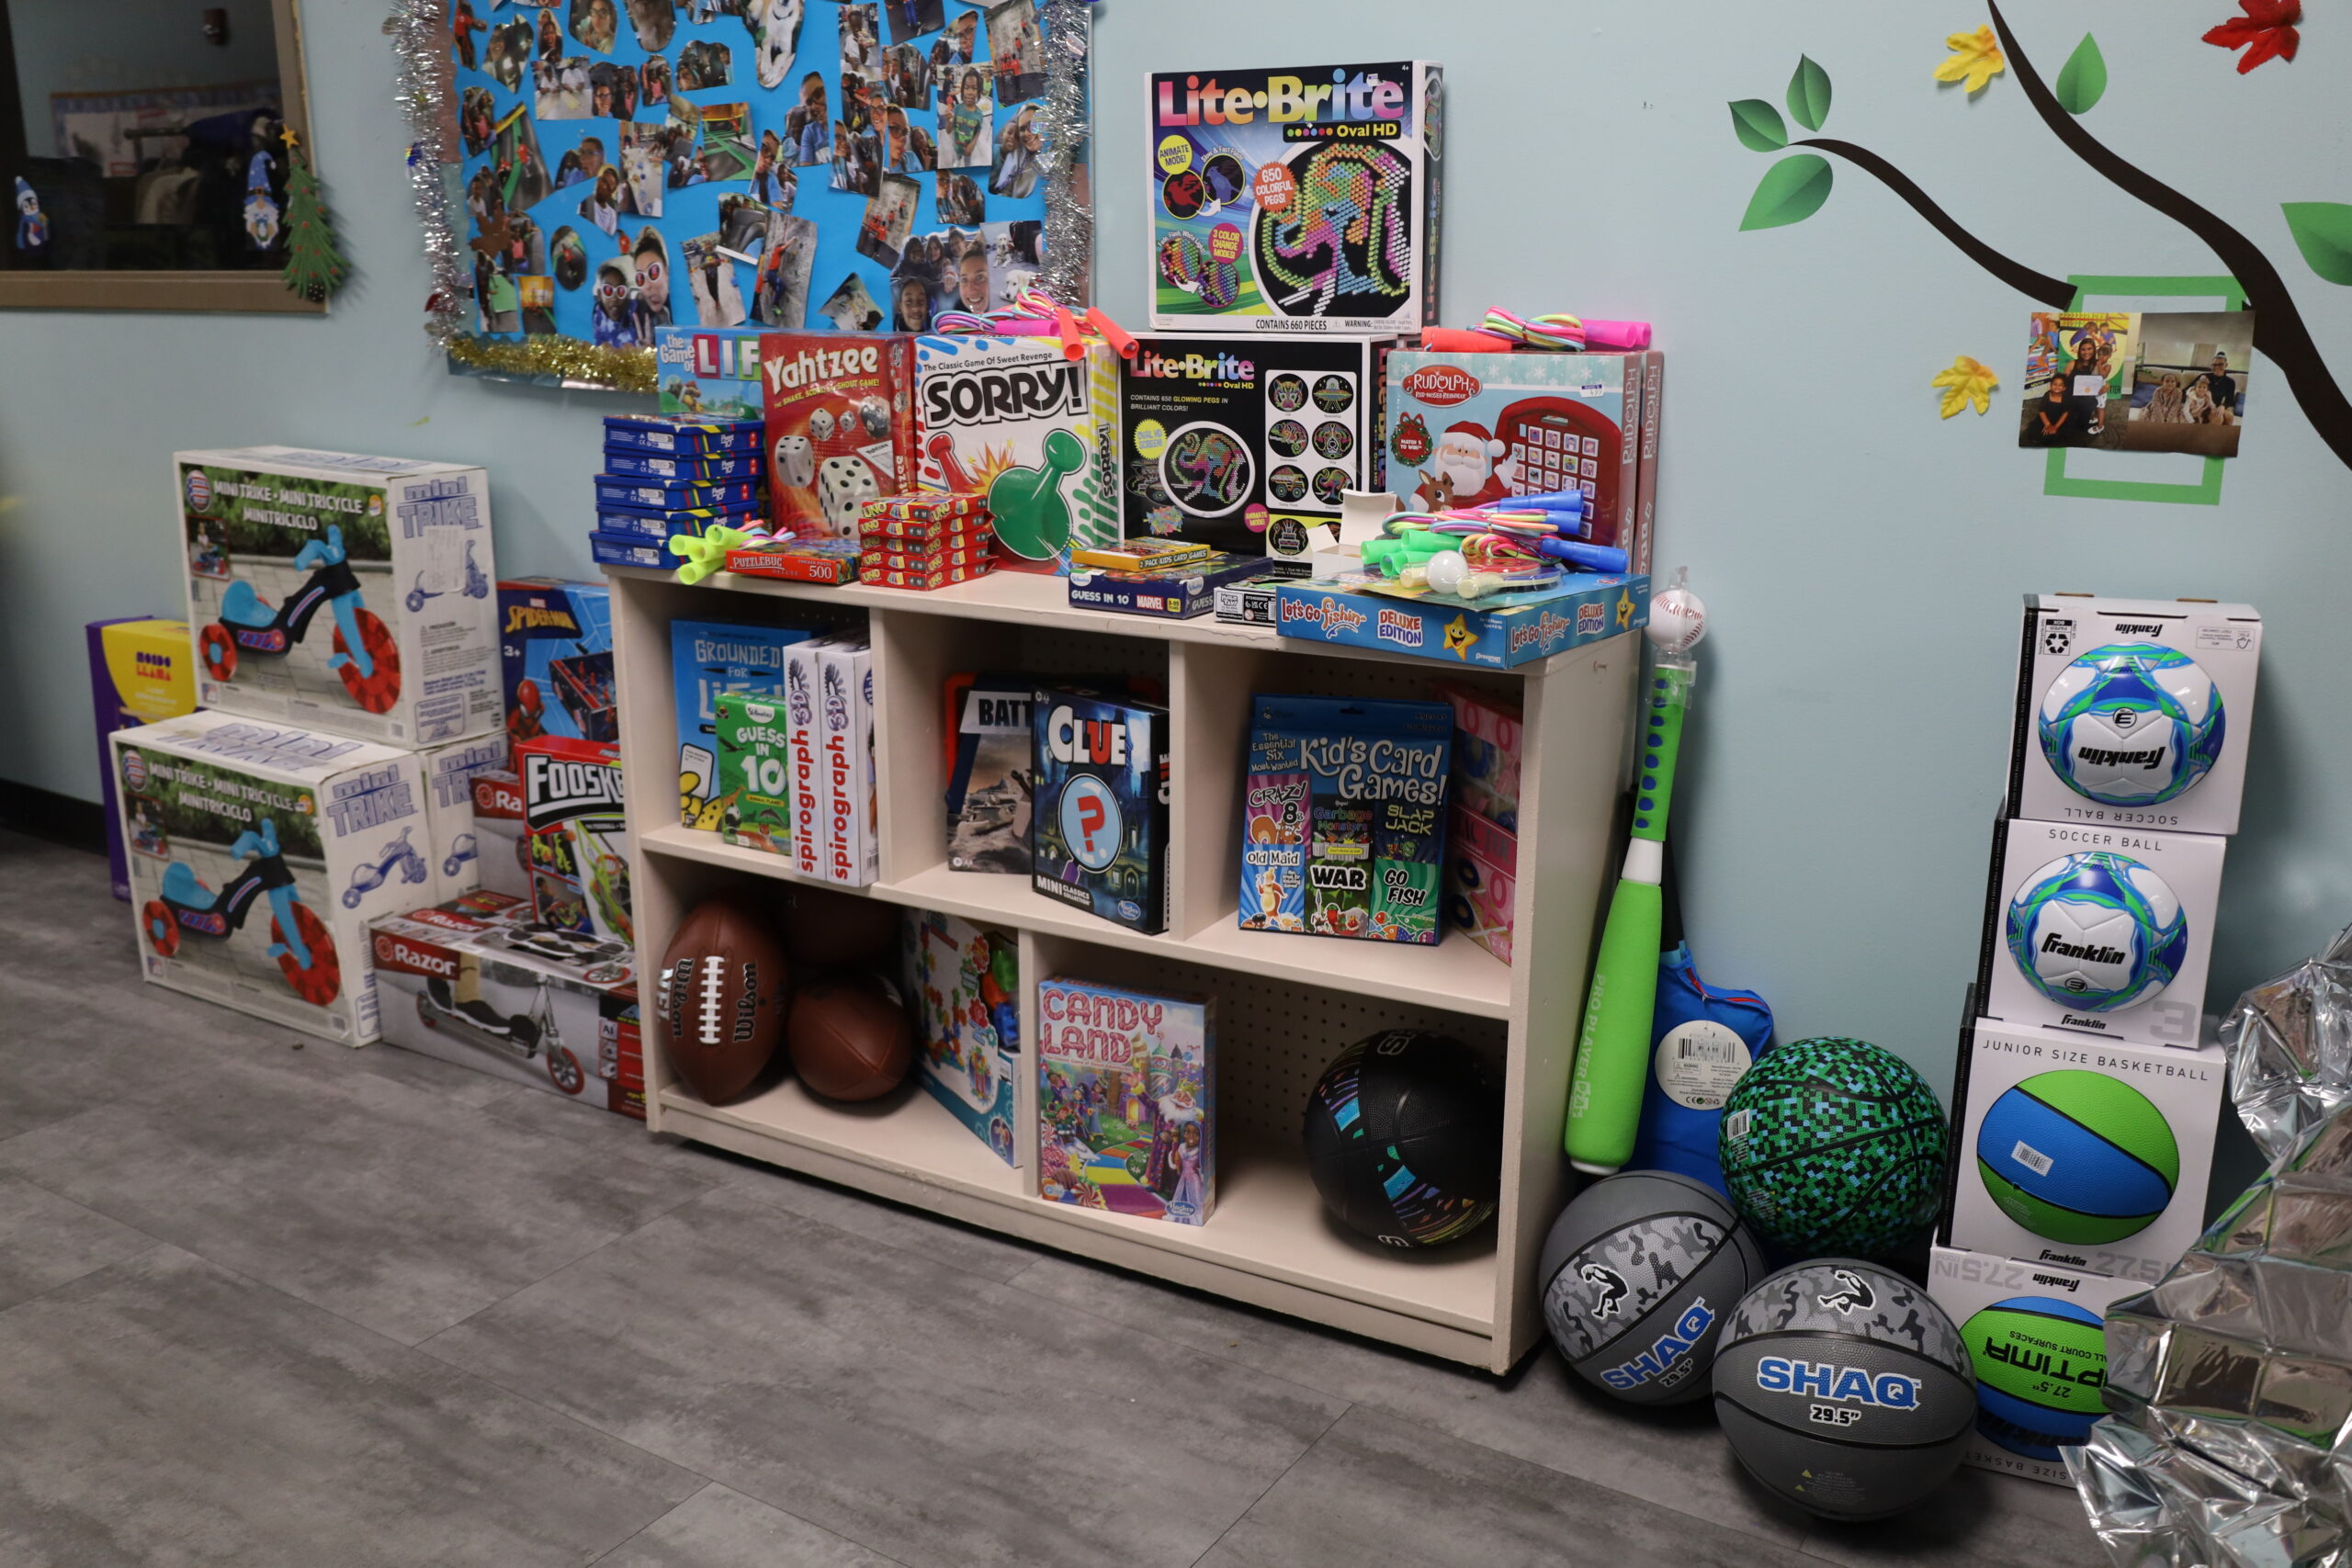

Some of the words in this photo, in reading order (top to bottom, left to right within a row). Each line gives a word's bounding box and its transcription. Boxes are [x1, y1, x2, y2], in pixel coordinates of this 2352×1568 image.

[1337, 123, 1371, 139] Oval
[1373, 122, 1397, 137] HD
[1159, 143, 1190, 159] ANIMATE
[1164, 154, 1187, 167] MODE!
[1261, 167, 1283, 182] 650
[1255, 180, 1294, 197] COLORFUL
[1264, 192, 1286, 206] PEGS!
[1212, 239, 1238, 251] CHANGE
[1219, 229, 1240, 243] COLOR
[1213, 249, 1237, 260] MODES!
[1256, 319, 1290, 330] CONTAINS
[1290, 320, 1304, 330] 660
[1304, 320, 1328, 331] PIECES
[1344, 320, 1374, 328] WARNING:
[667, 333, 684, 349] the
[660, 344, 695, 364] Game
[923, 363, 937, 372] The
[938, 361, 964, 371] Classic
[965, 359, 986, 368] Game
[987, 356, 996, 365] Of
[997, 355, 1020, 365] Sweet
[1021, 352, 1053, 363] Revenge
[684, 360, 695, 374] of
[763, 346, 878, 396] Yahtzee
[859, 378, 880, 388] GAME!
[1413, 373, 1470, 391] RUDOLPH
[925, 364, 1085, 425] SORRY!
[1130, 394, 1160, 402] CONTAINS
[1130, 402, 1161, 411] BRILLIANT
[1623, 367, 1637, 465] RUDOLPH
[1644, 365, 1658, 459] RUDOLPH
[1097, 423, 1114, 500] SORRY!
[214, 480, 239, 497] MINI
[240, 484, 271, 502] TRIKE
[279, 489, 307, 507] MINI
[308, 493, 363, 514] TRICYCLE
[404, 476, 468, 501] mini
[243, 507, 318, 531] MINITRICICLO
[397, 497, 478, 539] TRIKE
[862, 503, 887, 519] UNO
[930, 502, 950, 522] UNO
[861, 520, 879, 534] UNO
[927, 521, 942, 538] UNO
[861, 536, 880, 549] UNO
[861, 551, 881, 565] UNO
[1145, 558, 1158, 567] PACK
[1159, 556, 1172, 565] KIDS
[1173, 553, 1187, 563] CARD
[1189, 549, 1207, 561] GAMES
[808, 565, 832, 580] 500
[861, 568, 880, 582] UNO
[928, 571, 944, 588] UNO
[1071, 590, 1101, 602] GUESS
[1103, 592, 1114, 604] IN
[1117, 594, 1129, 604] 10
[1136, 594, 1164, 610] MARVEL
[1192, 595, 1213, 610] GUESS
[505, 605, 577, 634] SPIDER-MAN
[1281, 597, 1304, 623] Let's
[1305, 605, 1320, 621] Go
[1579, 603, 1604, 619] DELUXE
[1379, 611, 1421, 631] DELUXE
[1577, 615, 1605, 633] EDITION
[1378, 625, 1422, 644] EDITION
[1510, 626, 1528, 653] Let's
[1528, 626, 1541, 643] Go
[503, 646, 521, 657] 3+
[695, 639, 781, 669] GROUNDED
[736, 727, 786, 749] GUESS
[1047, 705, 1127, 766] CLUE
[1262, 732, 1279, 742] The
[755, 742, 770, 757] IN
[1251, 739, 1296, 752] Essential
[1266, 748, 1284, 761] Six
[439, 740, 501, 773] mini
[1251, 761, 1271, 773] Most
[1271, 758, 1299, 771] Wanted
[1300, 737, 1367, 777] Kid's
[1369, 739, 1443, 779] Card
[333, 763, 400, 798] mini
[740, 755, 787, 796] 10
[1338, 763, 1447, 806] Games!
[149, 761, 174, 780] MINI
[174, 768, 206, 790] TRIKE
[213, 774, 239, 796] MINI
[239, 784, 295, 812] TRICYCLE
[1249, 780, 1308, 808] CRAZY
[178, 791, 253, 823] MINITRICICLO
[326, 784, 412, 838] TRIKE
[790, 730, 819, 874] spirograph
[825, 735, 854, 882] spirograph
[1313, 807, 1374, 821] Garbage
[1387, 804, 1435, 820] SLAP
[2064, 807, 2104, 821] BALL
[2114, 812, 2178, 826] SOCCER
[1317, 819, 1368, 831] Monsters
[1385, 819, 1432, 836] JACK
[2049, 829, 2112, 846] SOCCER
[2121, 837, 2163, 852] BALL
[1246, 851, 1268, 865] Old
[1270, 851, 1299, 866] Maid
[1036, 874, 1063, 896] MINI
[1063, 884, 1091, 899] CLASSICS
[1310, 865, 1366, 890] WAR
[1384, 868, 1408, 886] GO
[1063, 892, 1091, 907] COLLECTION
[1386, 886, 1427, 907] FISH
[429, 913, 483, 932] Razor
[393, 943, 457, 978] Razor
[673, 958, 695, 1039] Wilson
[734, 962, 758, 1043] Wilson
[1587, 974, 1606, 1012] PRO
[1043, 988, 1163, 1035] CANDY
[2149, 1000, 2198, 1043] 3
[1043, 1022, 1133, 1064] LAND
[1576, 1014, 1599, 1089] PLAYER
[1983, 1039, 2043, 1057] JUNIOR
[2052, 1049, 2088, 1064] SIZE
[2098, 1056, 2209, 1081] BASKETBALL
[1933, 1260, 1960, 1278] IN
[1962, 1258, 2025, 1291] 27.5
[1600, 1296, 1715, 1391] SHAQ
[2009, 1330, 2059, 1351] SURFACES
[2060, 1345, 2092, 1359] COURT
[1756, 1355, 1923, 1412] SHAQ
[1809, 1404, 1861, 1427] 29.5"
[2032, 1464, 2067, 1480] SIZE
